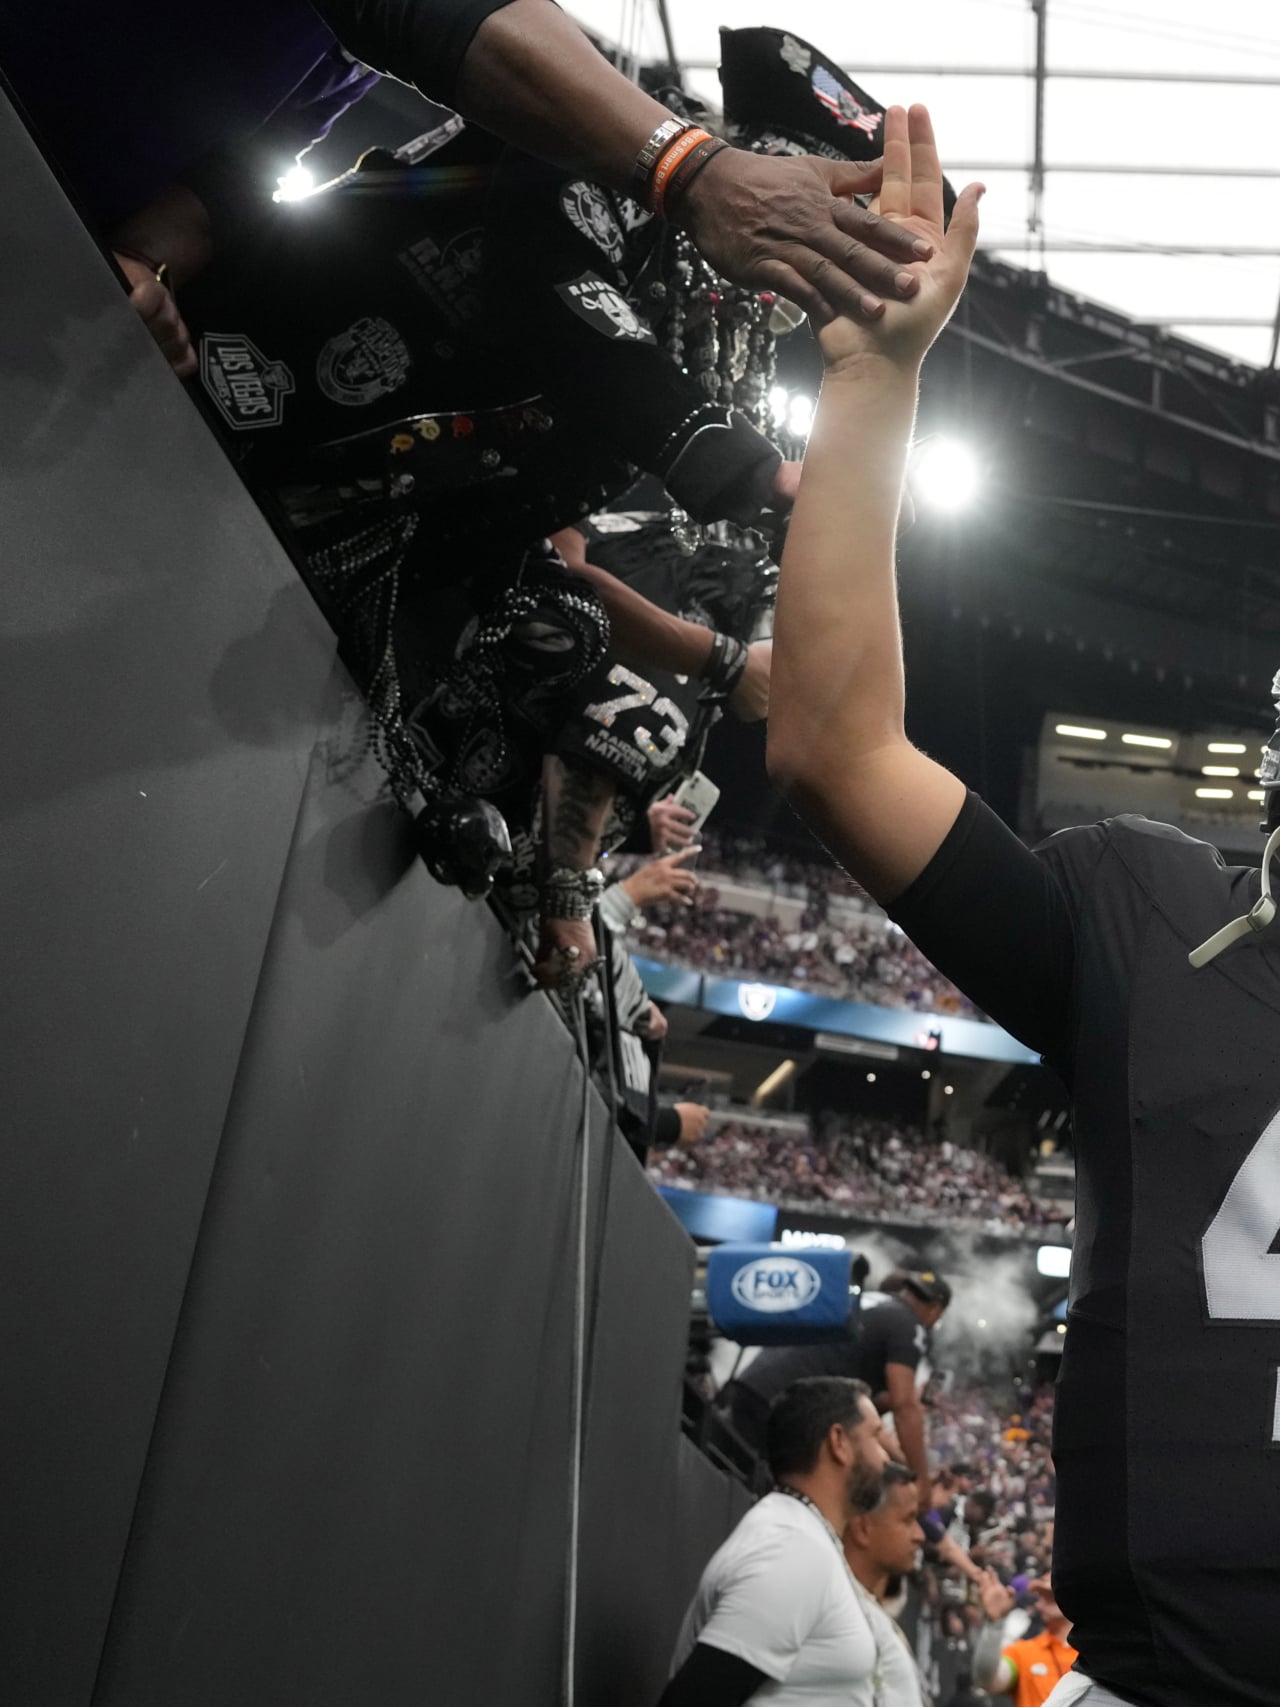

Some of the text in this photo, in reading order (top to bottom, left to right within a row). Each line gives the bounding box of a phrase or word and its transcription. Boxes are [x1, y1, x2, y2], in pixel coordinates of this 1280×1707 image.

[663, 147, 684, 170] Smart
[567, 280, 624, 298] RAID
[216, 346, 273, 415] LAS VEGAS
[583, 663, 690, 768] 73
[597, 728, 648, 766] RAIDER
[754, 1270, 798, 1289] FOX
